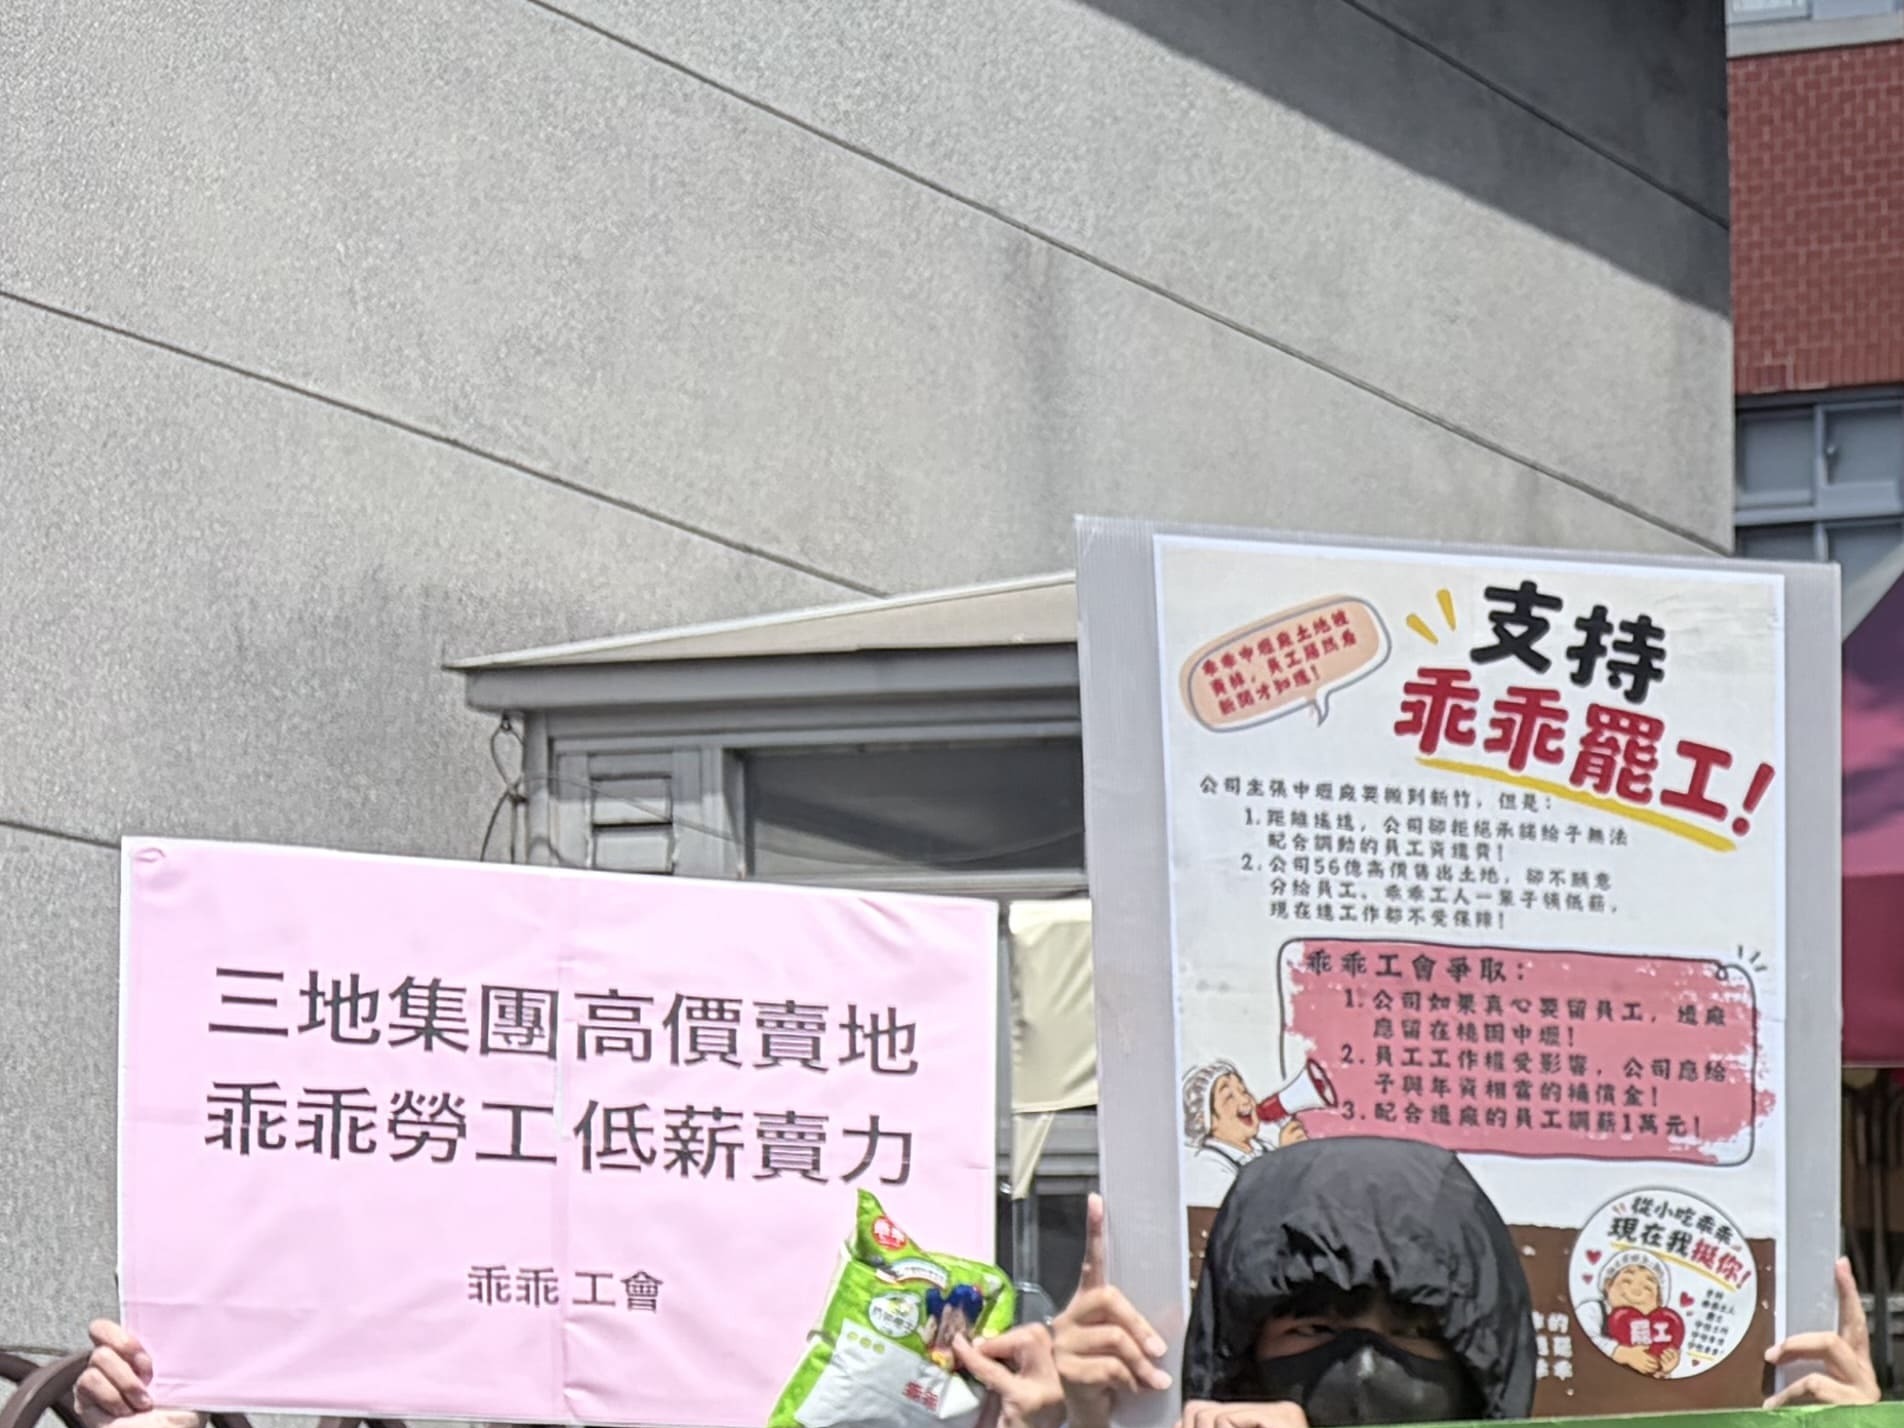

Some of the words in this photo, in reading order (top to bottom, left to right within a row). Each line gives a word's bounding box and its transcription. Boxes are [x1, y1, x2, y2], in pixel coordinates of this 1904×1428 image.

[1470, 580, 1666, 703] 支持
[208, 966, 919, 1076] 三地集團高價賣地
[204, 1081, 914, 1187] 乖乖勞工低薪賣力
[467, 1264, 664, 1313] 乖乖工會
